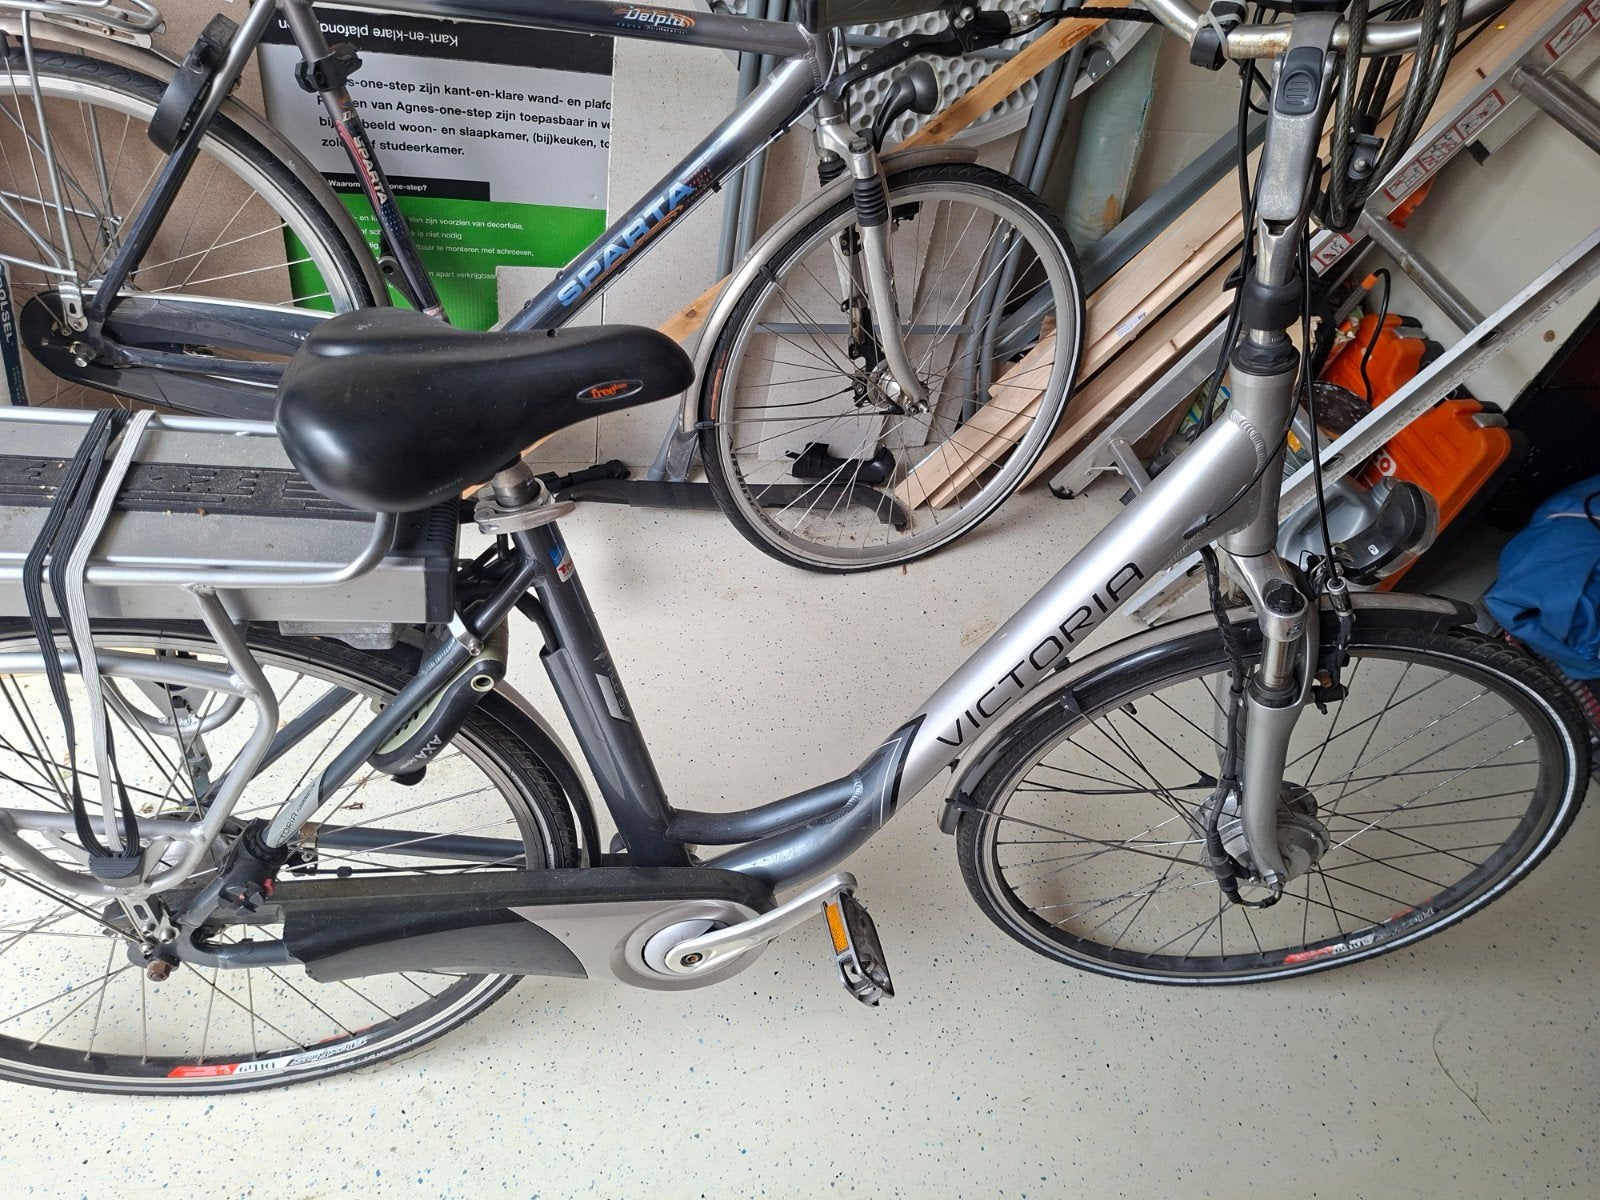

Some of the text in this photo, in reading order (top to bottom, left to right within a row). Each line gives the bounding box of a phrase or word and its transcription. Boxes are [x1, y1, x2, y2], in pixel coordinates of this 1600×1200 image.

[373, 27, 459, 47] Kant-en-klare
[420, 83, 441, 95] zijn
[444, 85, 524, 101] kant-en-klare
[528, 93, 563, 104] wand-
[567, 98, 581, 107] en
[371, 101, 393, 110] van
[396, 101, 492, 119] Agnes-one-step
[496, 110, 516, 122] zijn
[520, 112, 584, 126] toepasbaar
[588, 118, 598, 128] in
[399, 123, 437, 133] woon-
[441, 127, 455, 135] en
[460, 127, 529, 142] slaapkamer,
[533, 132, 597, 148] (bij)keuken,
[380, 141, 465, 155] studeerkamer.
[354, 135, 388, 204] SPARTA
[328, 180, 361, 188] Waarom
[425, 217, 438, 225] zijn
[446, 245, 480, 253] monteren
[557, 182, 696, 307] SPARTA
[936, 562, 1145, 747] VICTORIA
[415, 734, 442, 759] AXA
